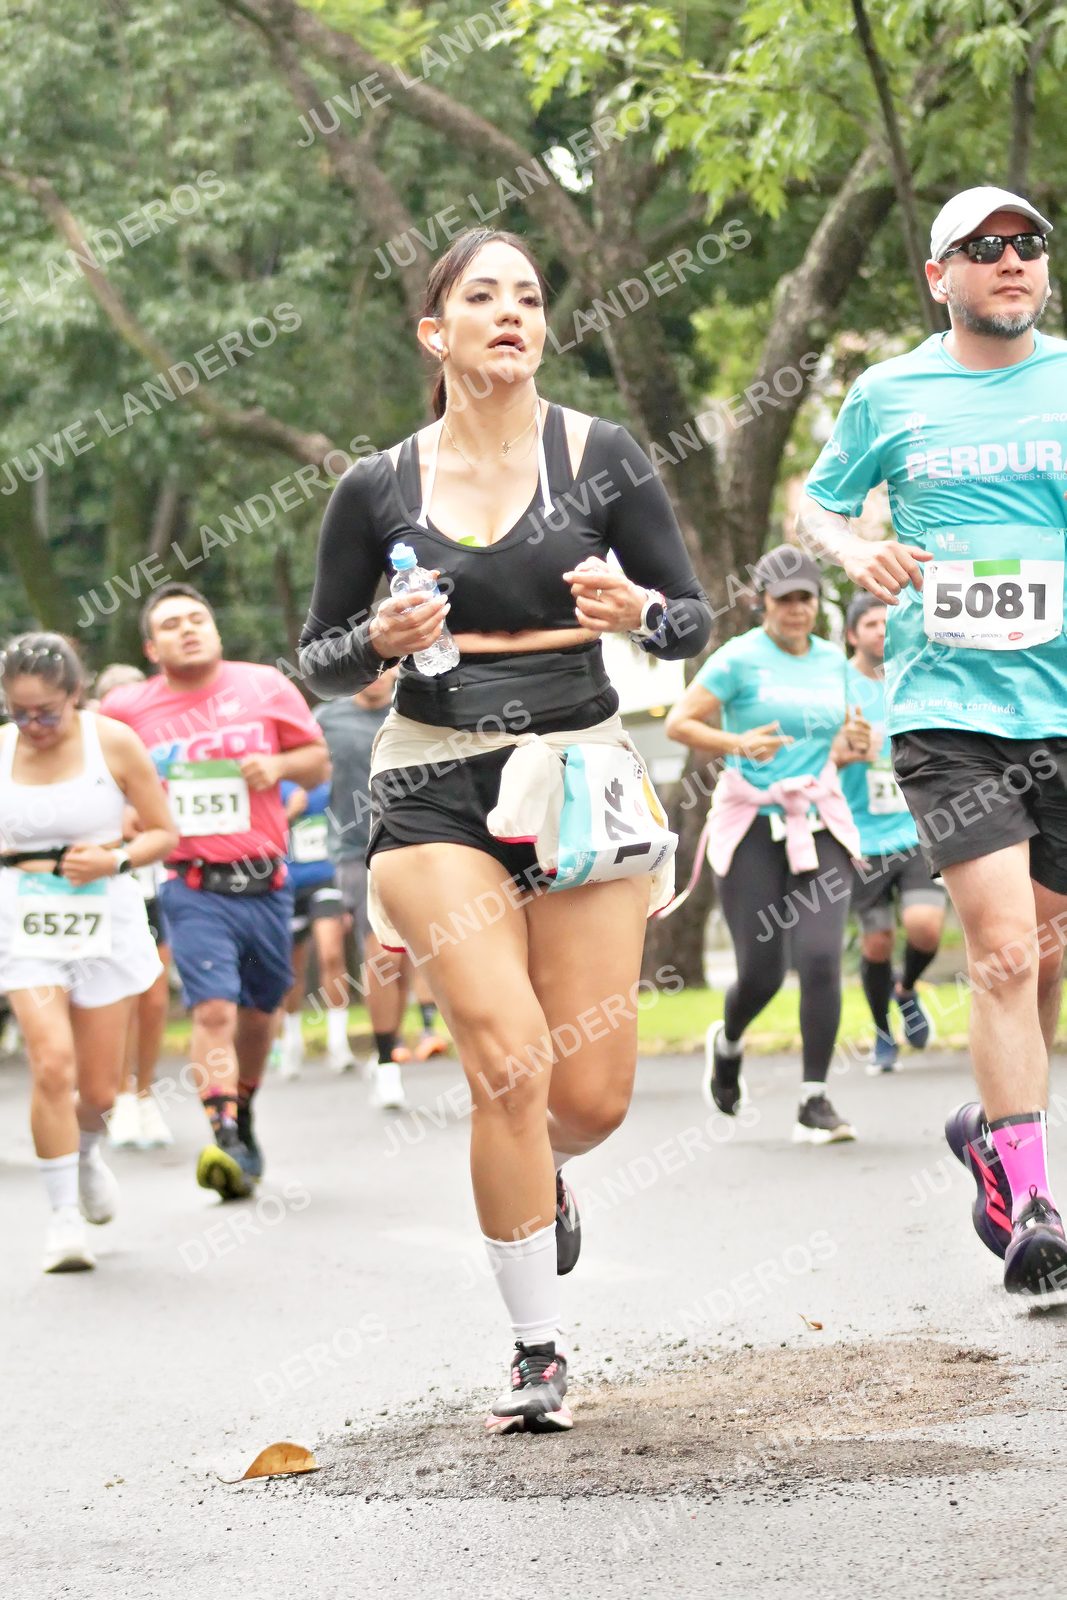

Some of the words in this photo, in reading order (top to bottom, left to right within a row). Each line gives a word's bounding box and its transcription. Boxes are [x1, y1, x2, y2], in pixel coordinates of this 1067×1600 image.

[905, 440, 1067, 482] PERDUR
[933, 582, 1046, 620] 5081
[175, 793, 239, 815] 1551
[603, 776, 652, 865] 174
[23, 912, 103, 936] 6527
